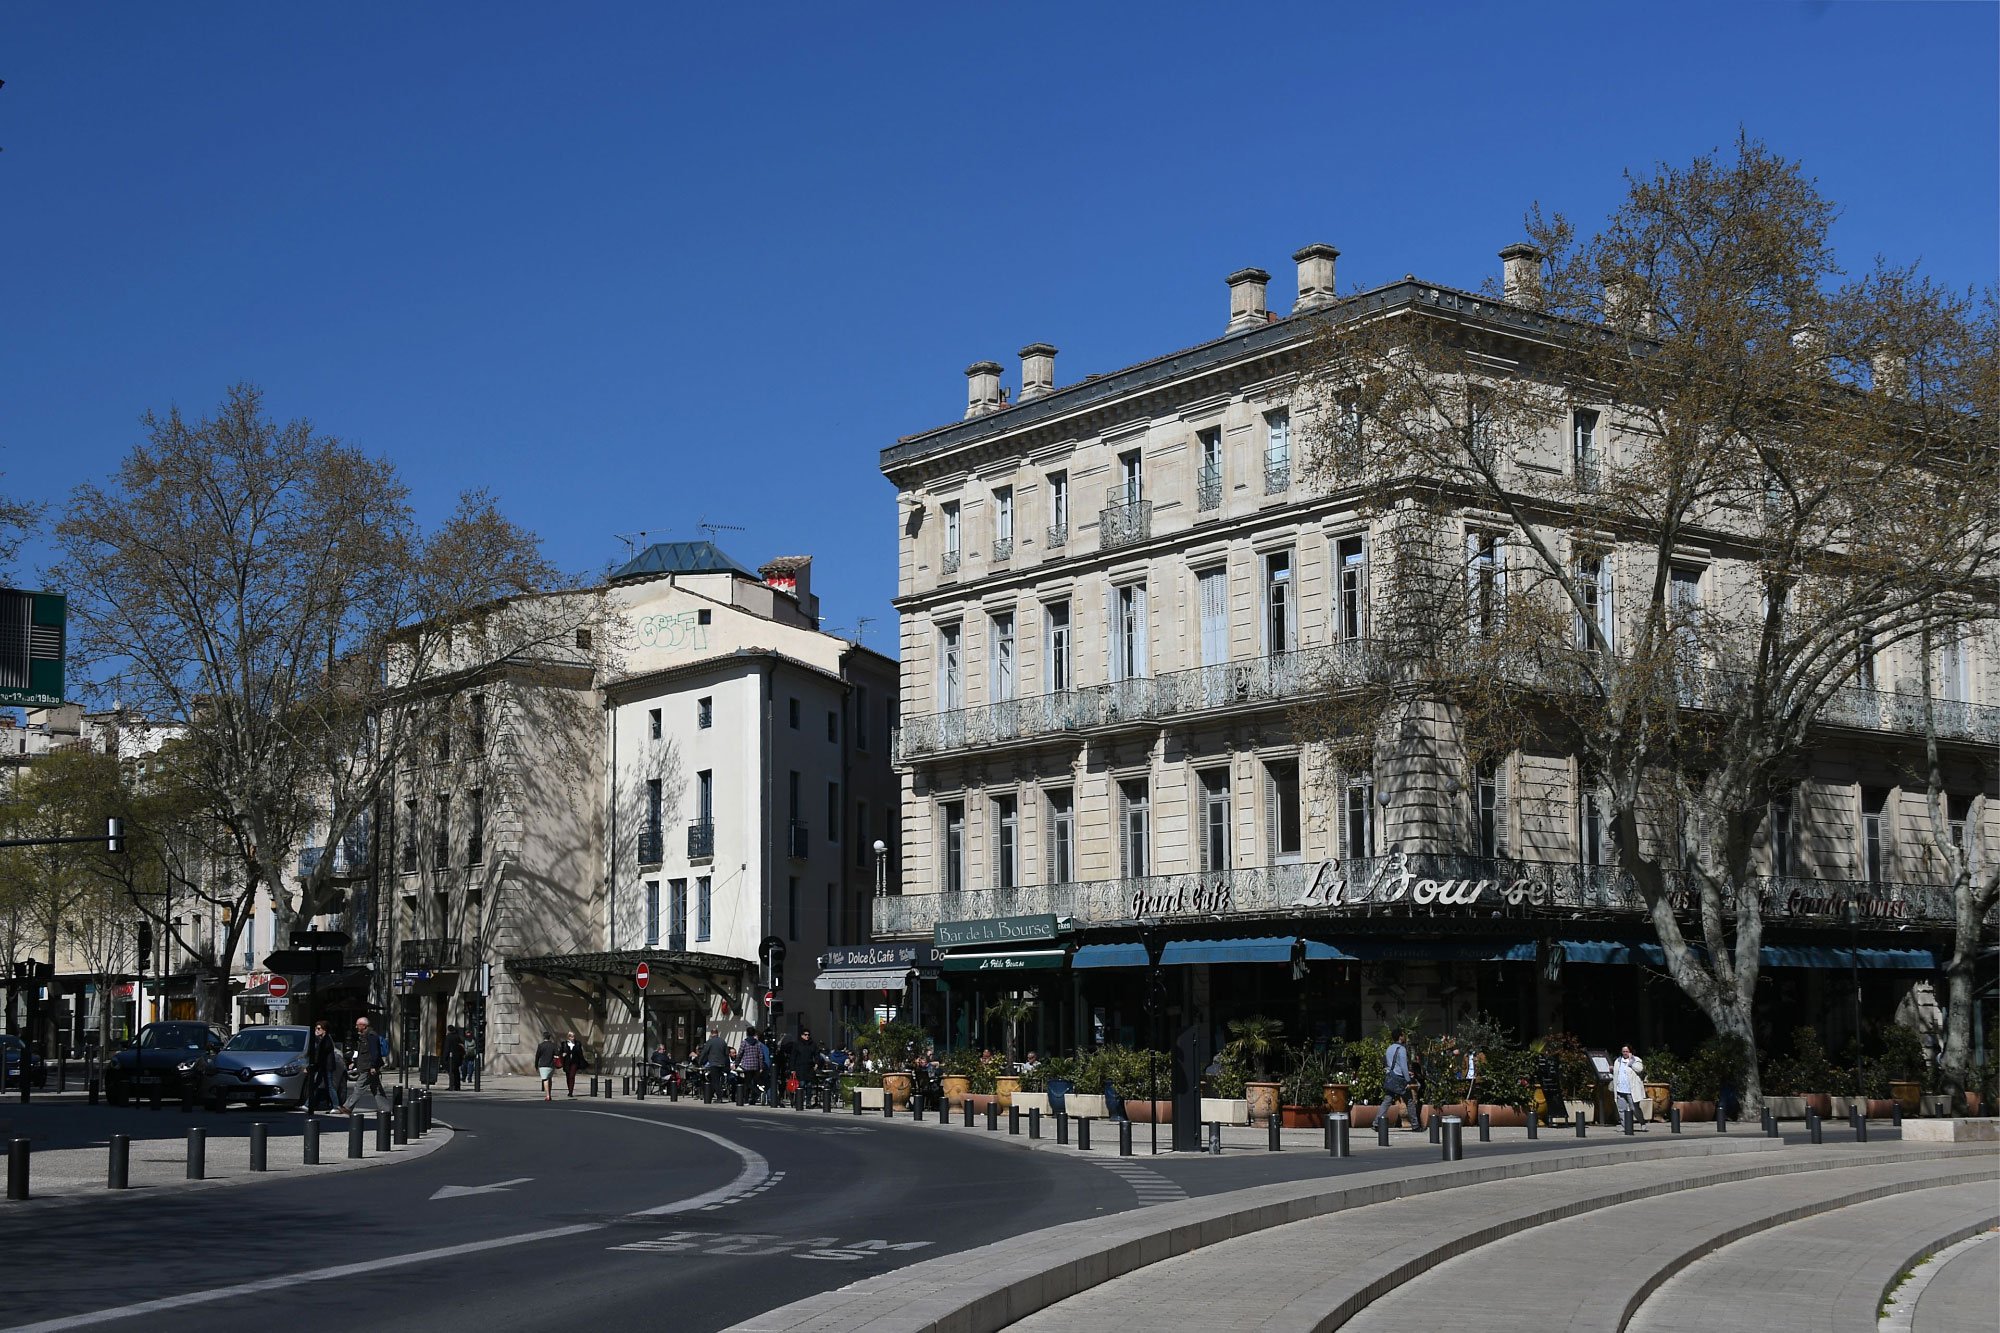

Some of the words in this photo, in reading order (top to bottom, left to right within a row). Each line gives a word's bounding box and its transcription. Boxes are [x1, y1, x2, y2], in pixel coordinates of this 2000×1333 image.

[1292, 857, 1347, 907] La
[1349, 853, 1548, 905] Bourse
[1131, 883, 1186, 919] Grand
[1192, 881, 1231, 911] Café
[939, 927, 962, 943] Bar
[966, 927, 980, 940] de
[984, 925, 994, 939] la
[998, 921, 1051, 939] Bourse
[848, 952, 869, 964] Dolce
[877, 949, 895, 964] Café
[831, 979, 857, 989] dolce
[605, 1241, 880, 1261] BUS
[658, 1231, 936, 1251] TRAM
